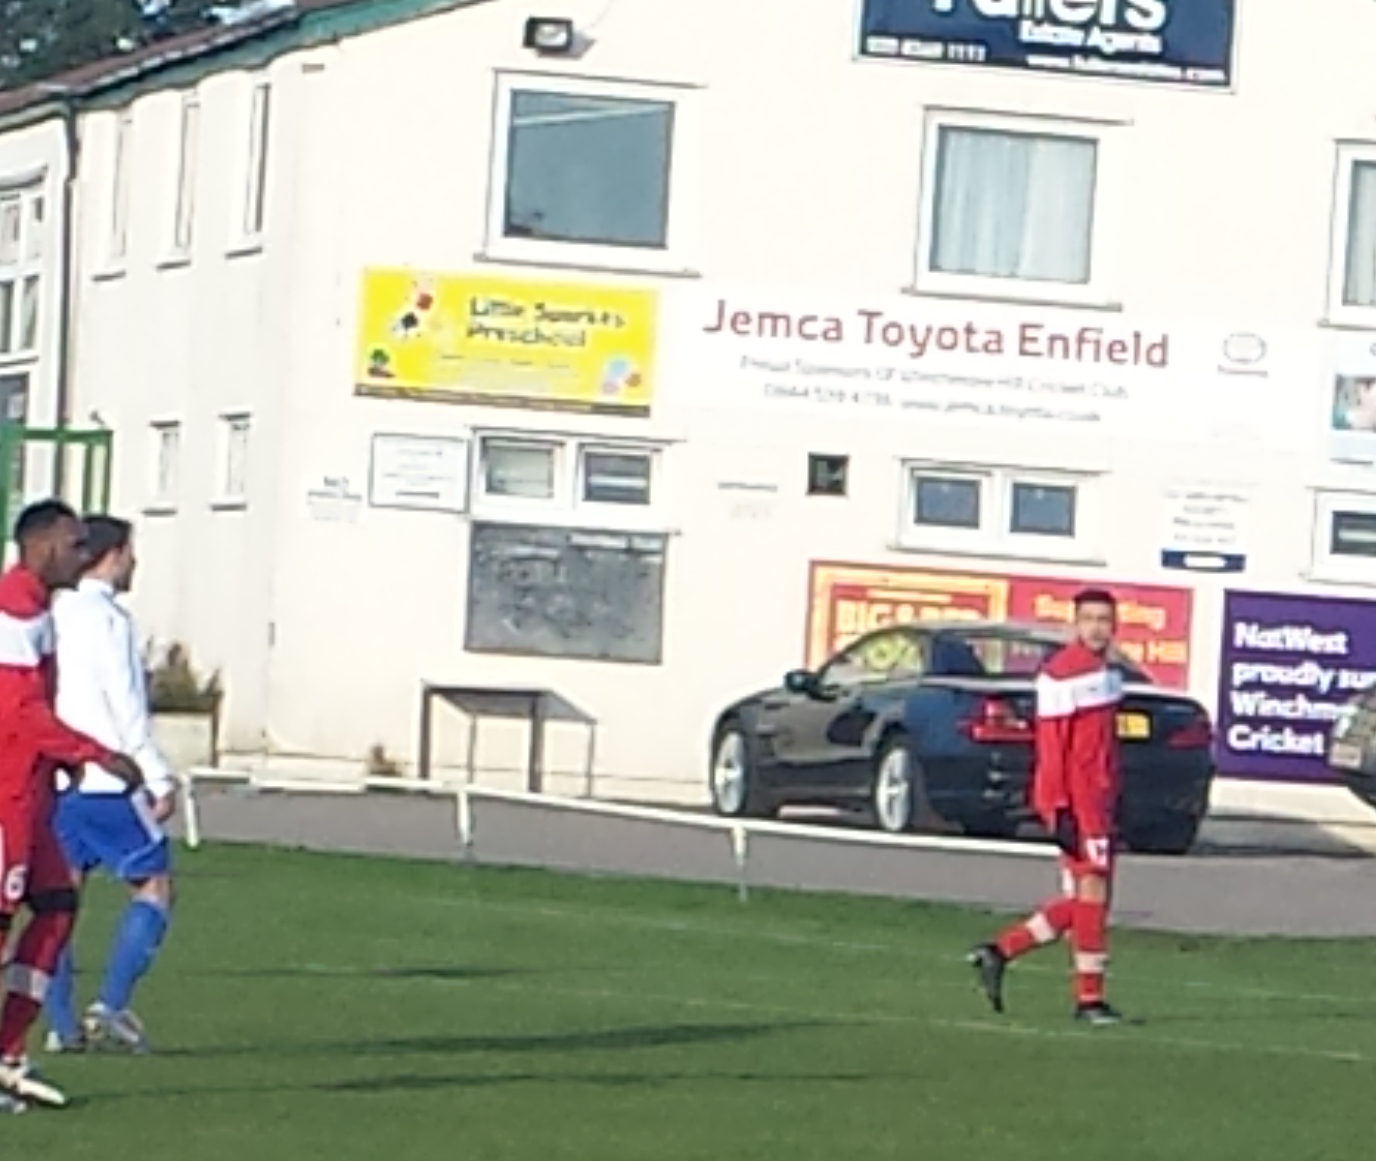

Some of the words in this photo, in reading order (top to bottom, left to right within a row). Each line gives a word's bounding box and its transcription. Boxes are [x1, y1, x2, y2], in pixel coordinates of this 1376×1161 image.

[469, 296, 524, 317] Little
[466, 323, 586, 347] Preschool
[702, 298, 844, 343] Jemca
[857, 309, 1004, 358] Toyota
[1018, 323, 1169, 368] Enfield
[1034, 593, 1167, 631] Supting
[1233, 621, 1349, 655] NatWest
[1231, 660, 1336, 694] proudly
[1229, 690, 1340, 721] Winchm
[1226, 723, 1325, 755] Cricket
